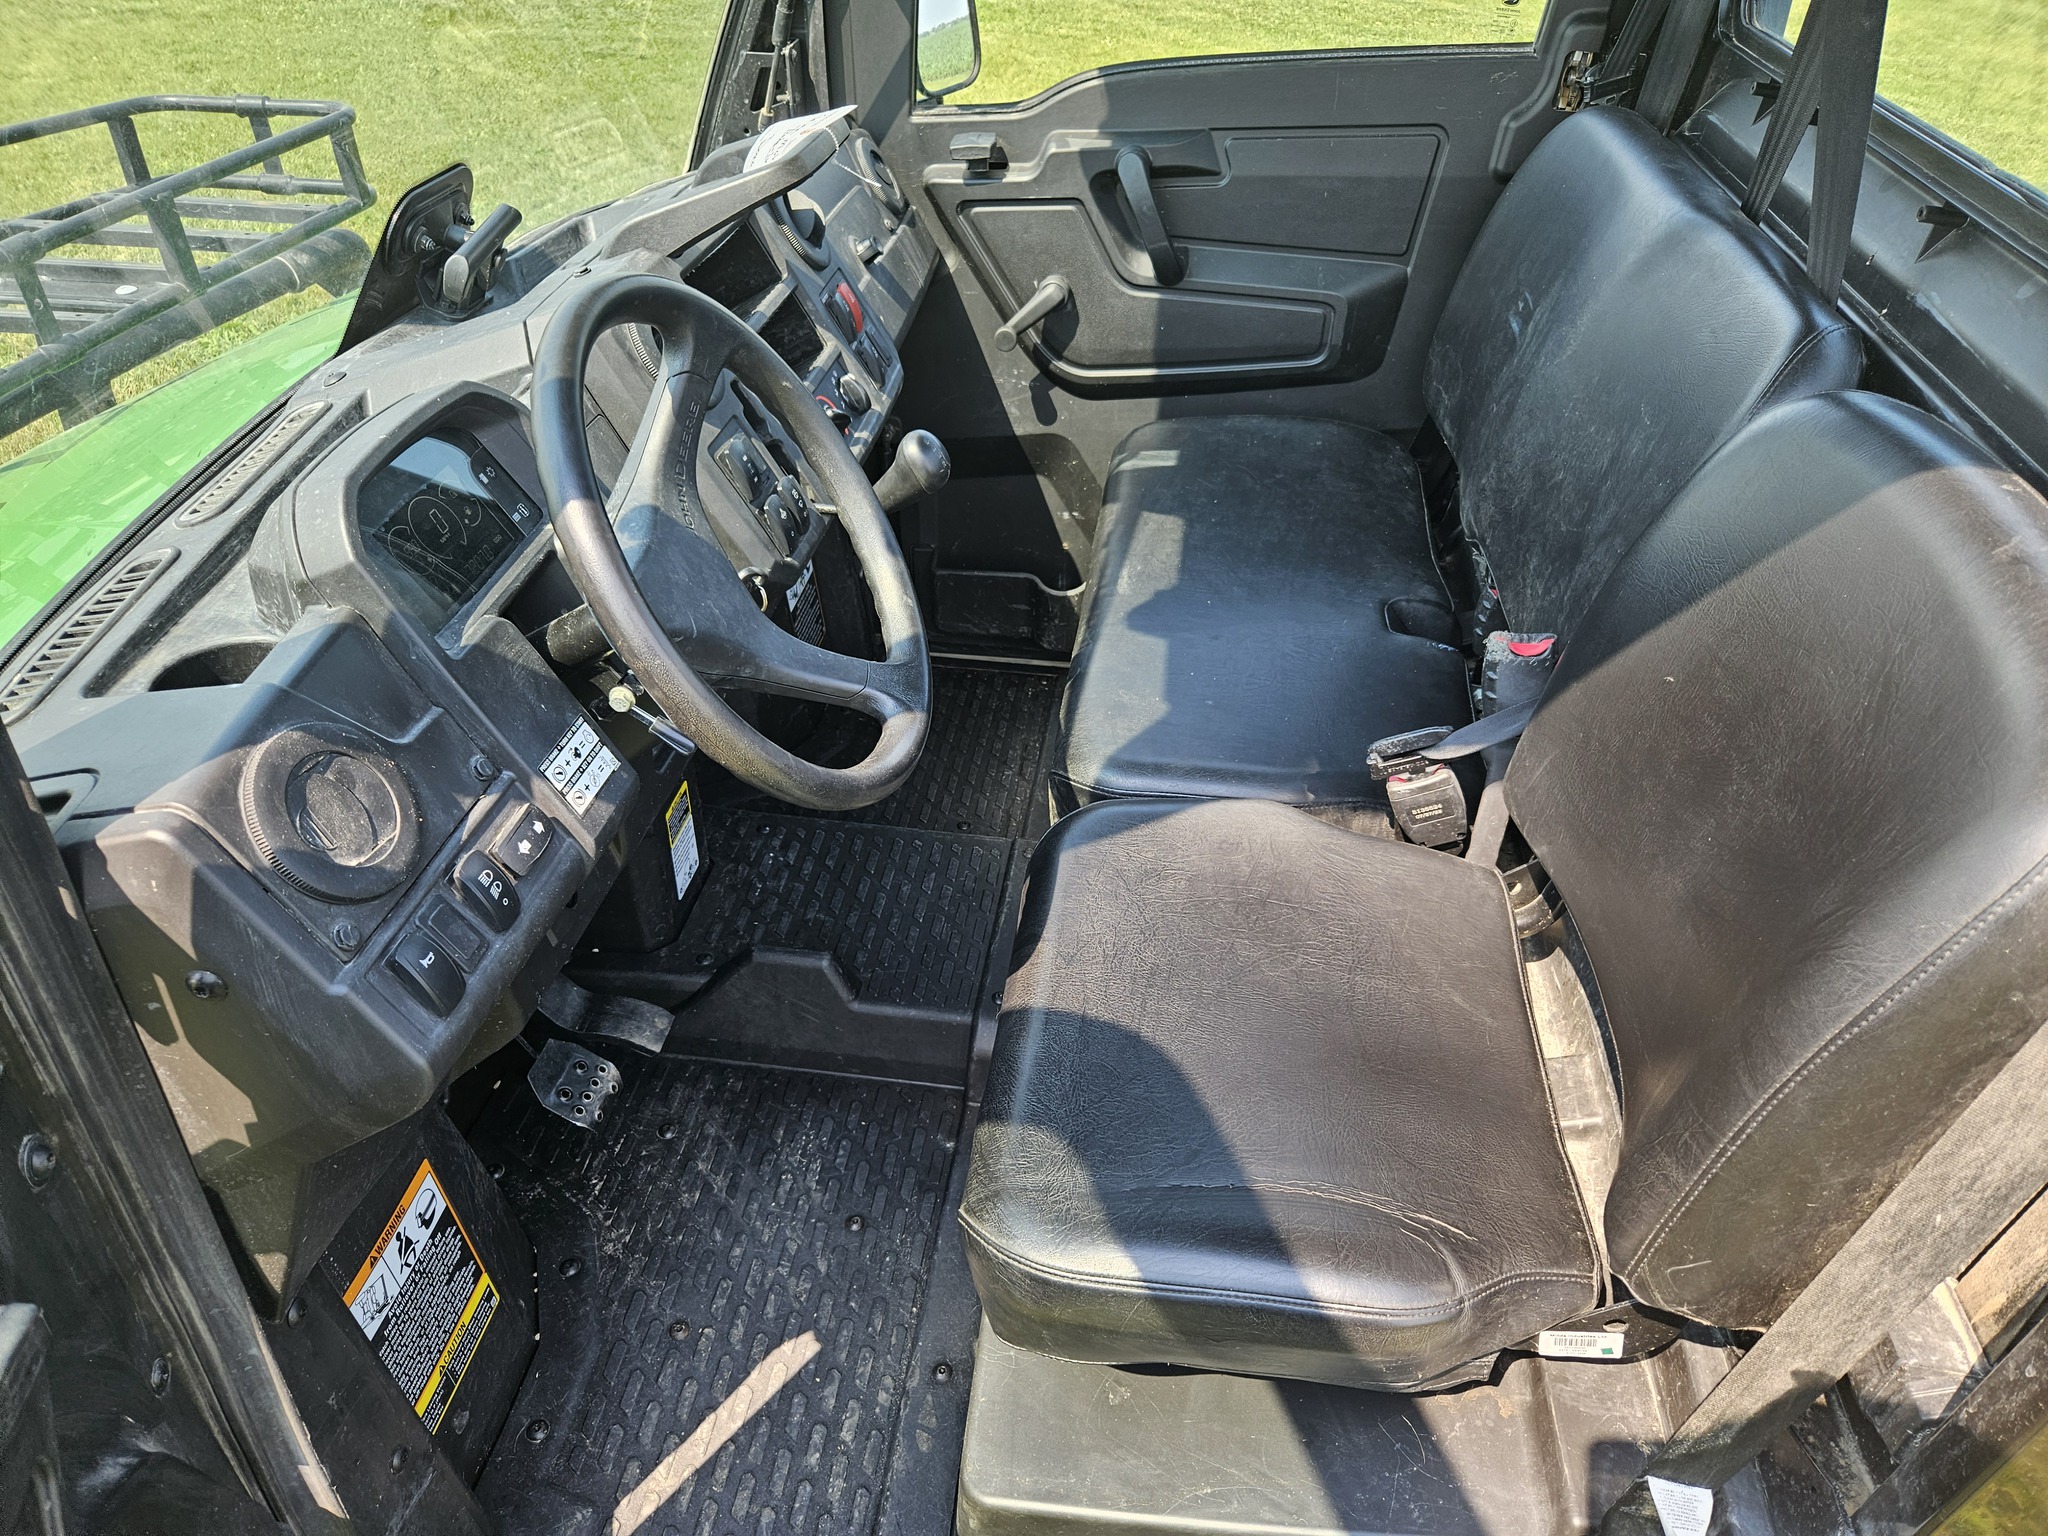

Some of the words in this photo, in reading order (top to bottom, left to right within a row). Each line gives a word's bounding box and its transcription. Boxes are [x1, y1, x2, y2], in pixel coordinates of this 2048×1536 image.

[675, 401, 700, 480] DEERE
[676, 482, 698, 535] JOHN
[374, 1203, 405, 1257] WARNING
[383, 1314, 396, 1338] from
[395, 1280, 415, 1316] Rollover
[413, 1270, 420, 1282] or
[419, 1243, 435, 1272] Falling
[433, 1230, 442, 1246] Off
[387, 1293, 402, 1319] Avoid
[400, 1269, 415, 1296] Injury
[414, 1259, 421, 1272] or
[419, 1237, 433, 1262] Death
[443, 1320, 466, 1365] CAUTION
